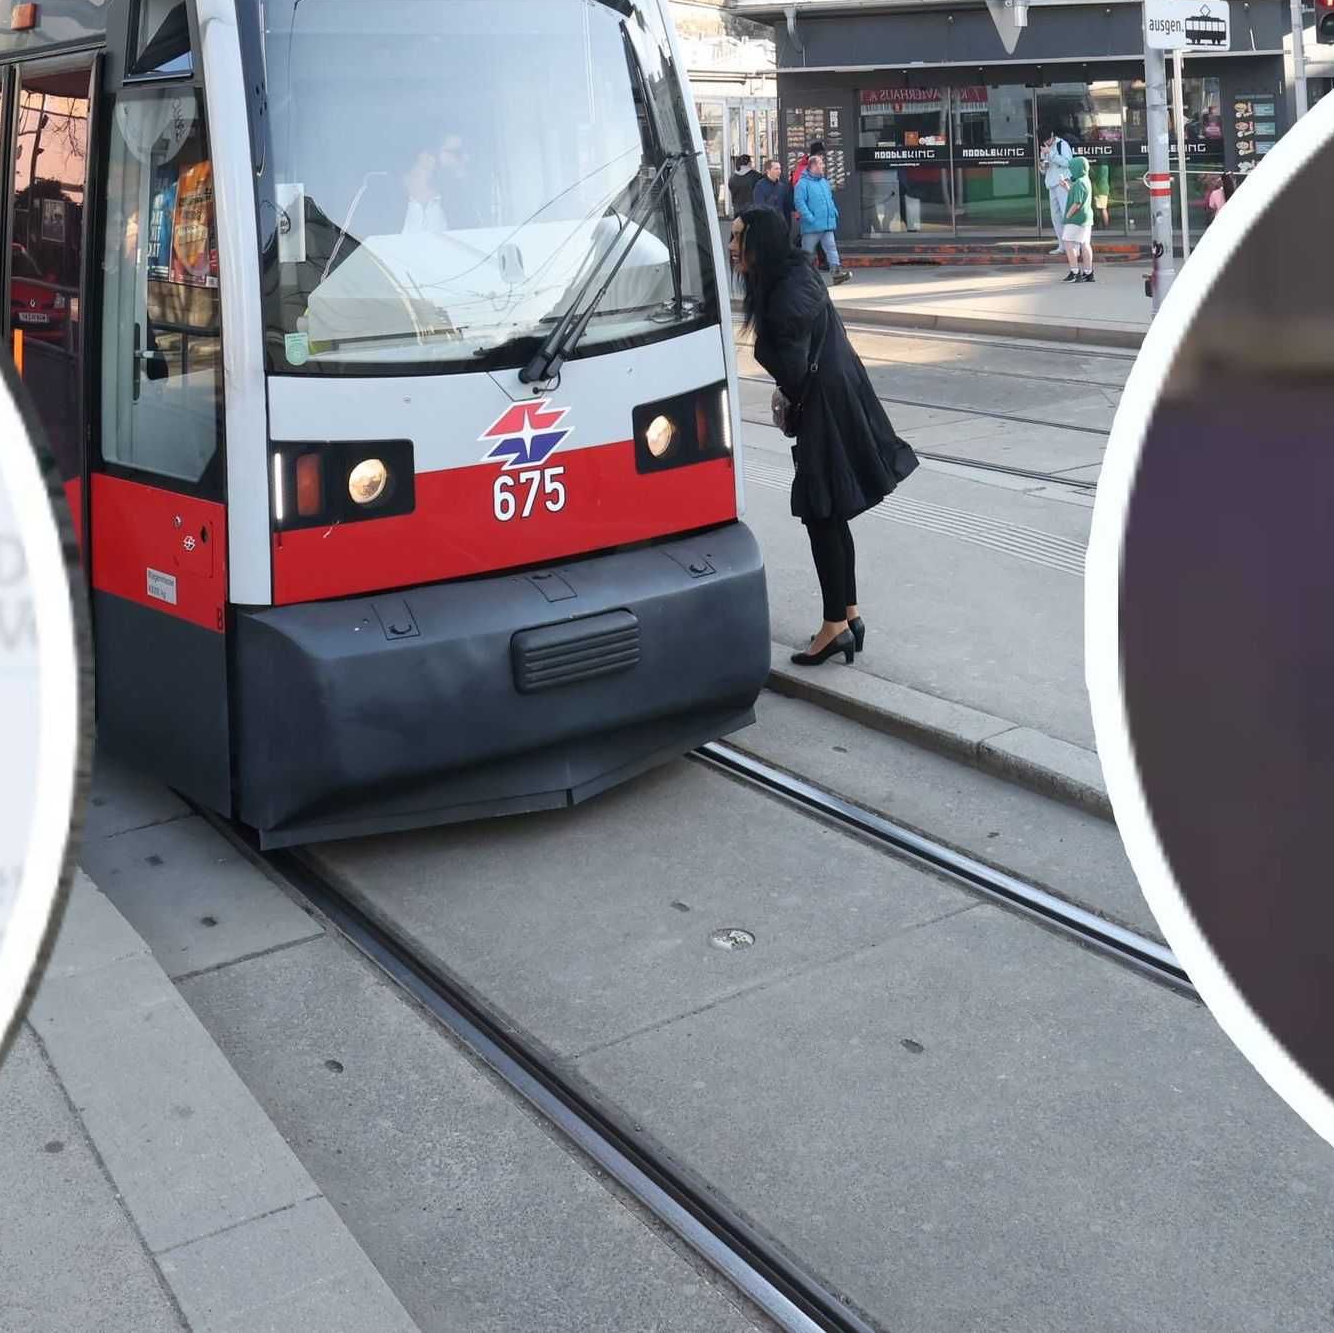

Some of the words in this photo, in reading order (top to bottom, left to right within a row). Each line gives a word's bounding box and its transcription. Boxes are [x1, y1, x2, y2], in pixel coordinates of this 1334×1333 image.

[1148, 18, 1184, 35] ausgen.
[874, 149, 936, 160] NOODLEKING
[962, 147, 1025, 158] NOODLEKING
[493, 466, 566, 522] 675
